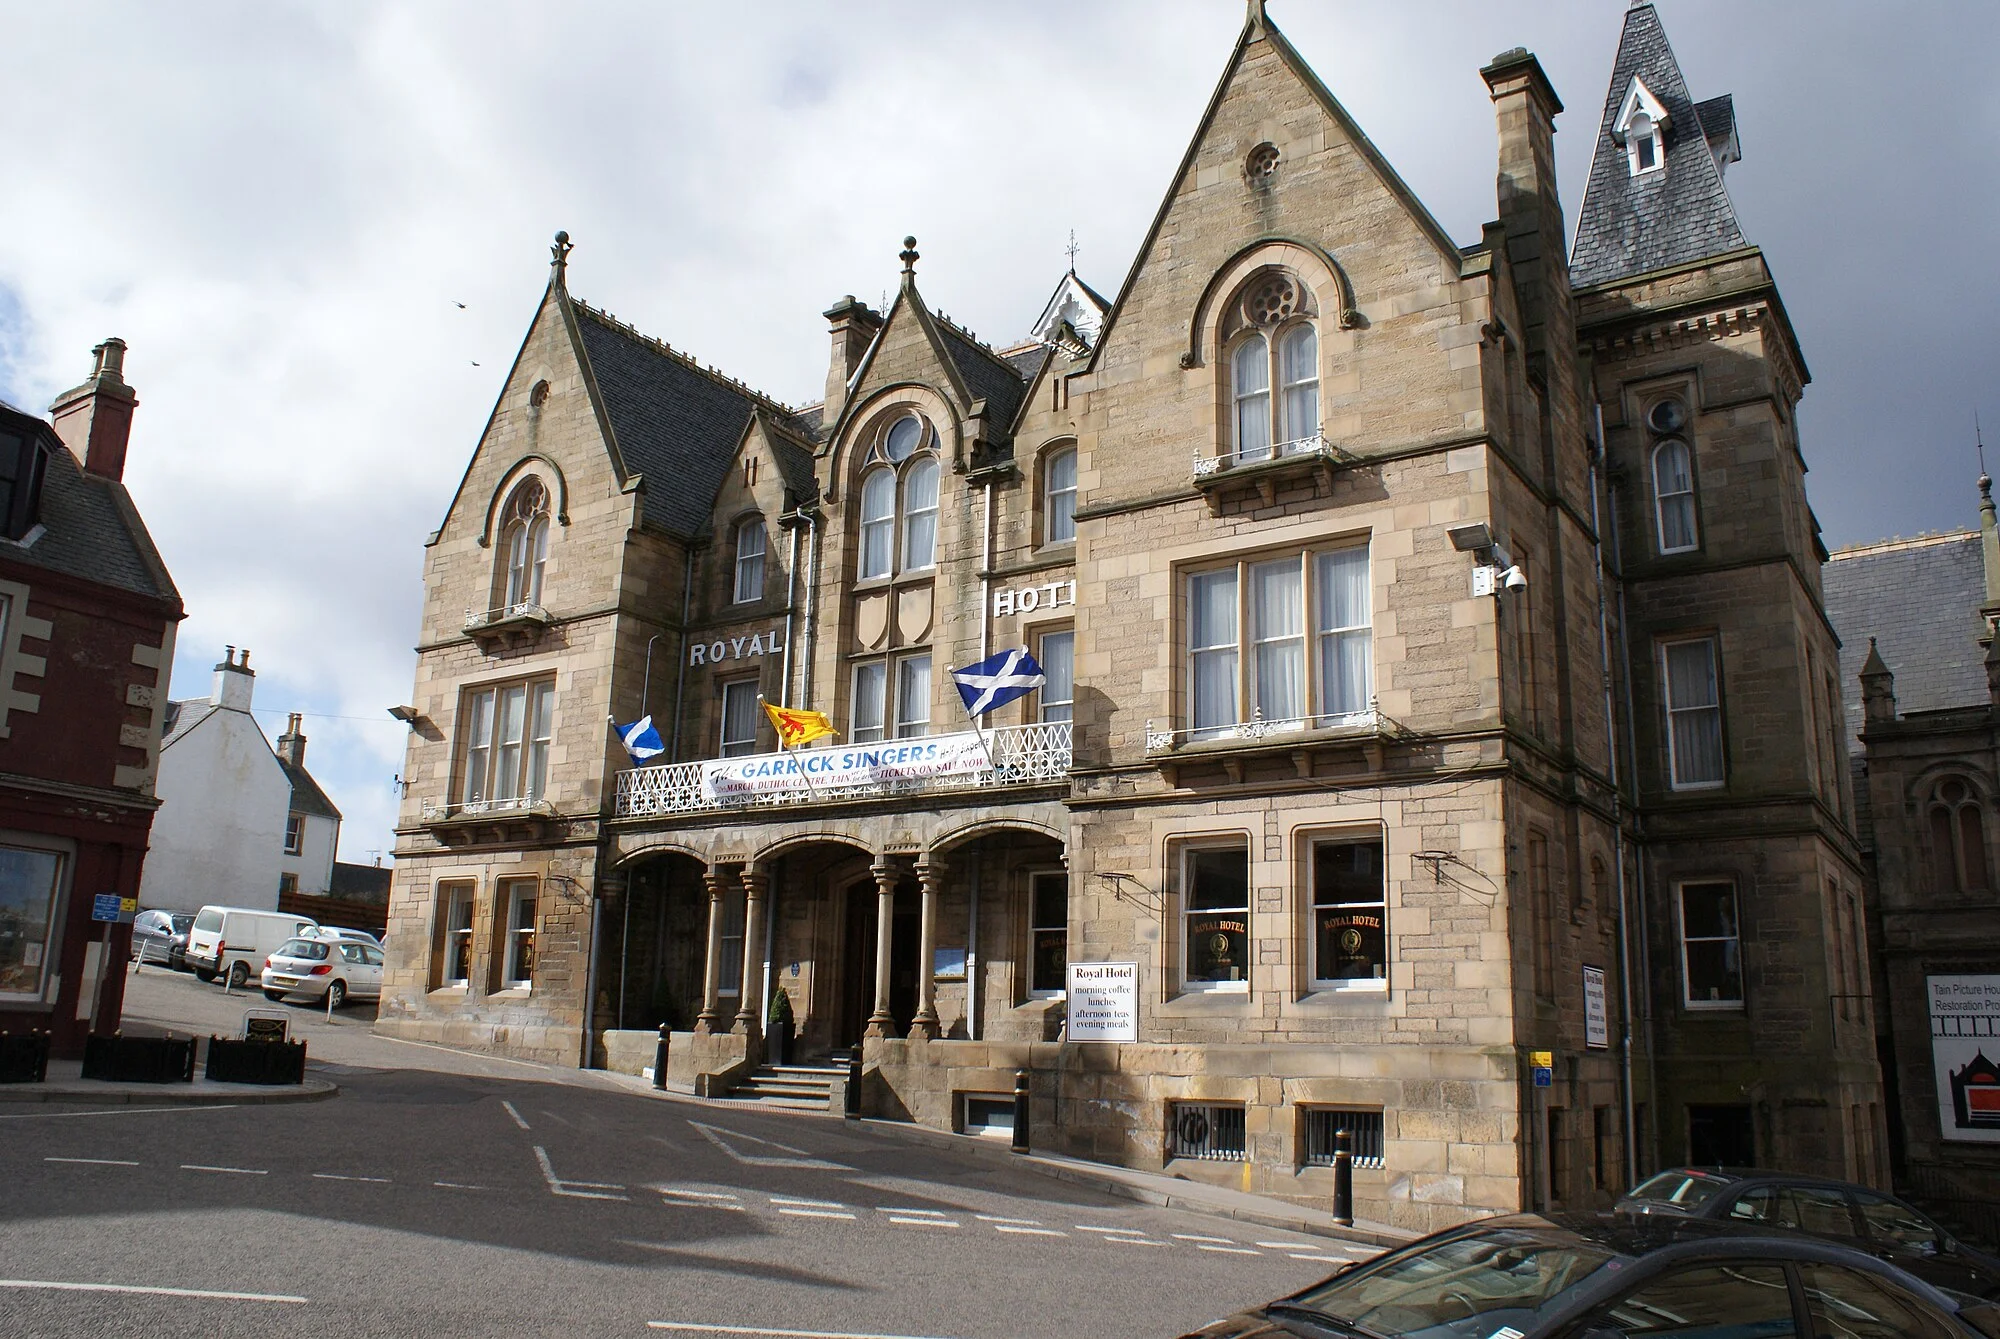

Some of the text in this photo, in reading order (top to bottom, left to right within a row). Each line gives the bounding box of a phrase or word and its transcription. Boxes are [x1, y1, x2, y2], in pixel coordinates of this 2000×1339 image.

[690, 631, 783, 667] ROYAL
[710, 765, 737, 784] The
[741, 756, 834, 778] GARRICK
[843, 744, 937, 769] SINGERS
[881, 766, 917, 778] TICKETS
[920, 764, 932, 775] ON
[962, 757, 985, 769] NOW
[758, 779, 791, 790] DUTHAC
[1219, 920, 1245, 933] HOTEL
[1324, 915, 1380, 929] ROYAL HOTEL
[1076, 967, 1132, 981] Royal Hotel
[1075, 985, 1131, 995] morning coffee
[1933, 984, 1951, 995] Tain
[1952, 983, 1982, 995] Picture
[1088, 997, 1117, 1006] lunches
[1935, 999, 1983, 1011] Restoration
[1075, 1009, 1130, 1018] afternoon teas
[1076, 1019, 1129, 1030] evening meals
